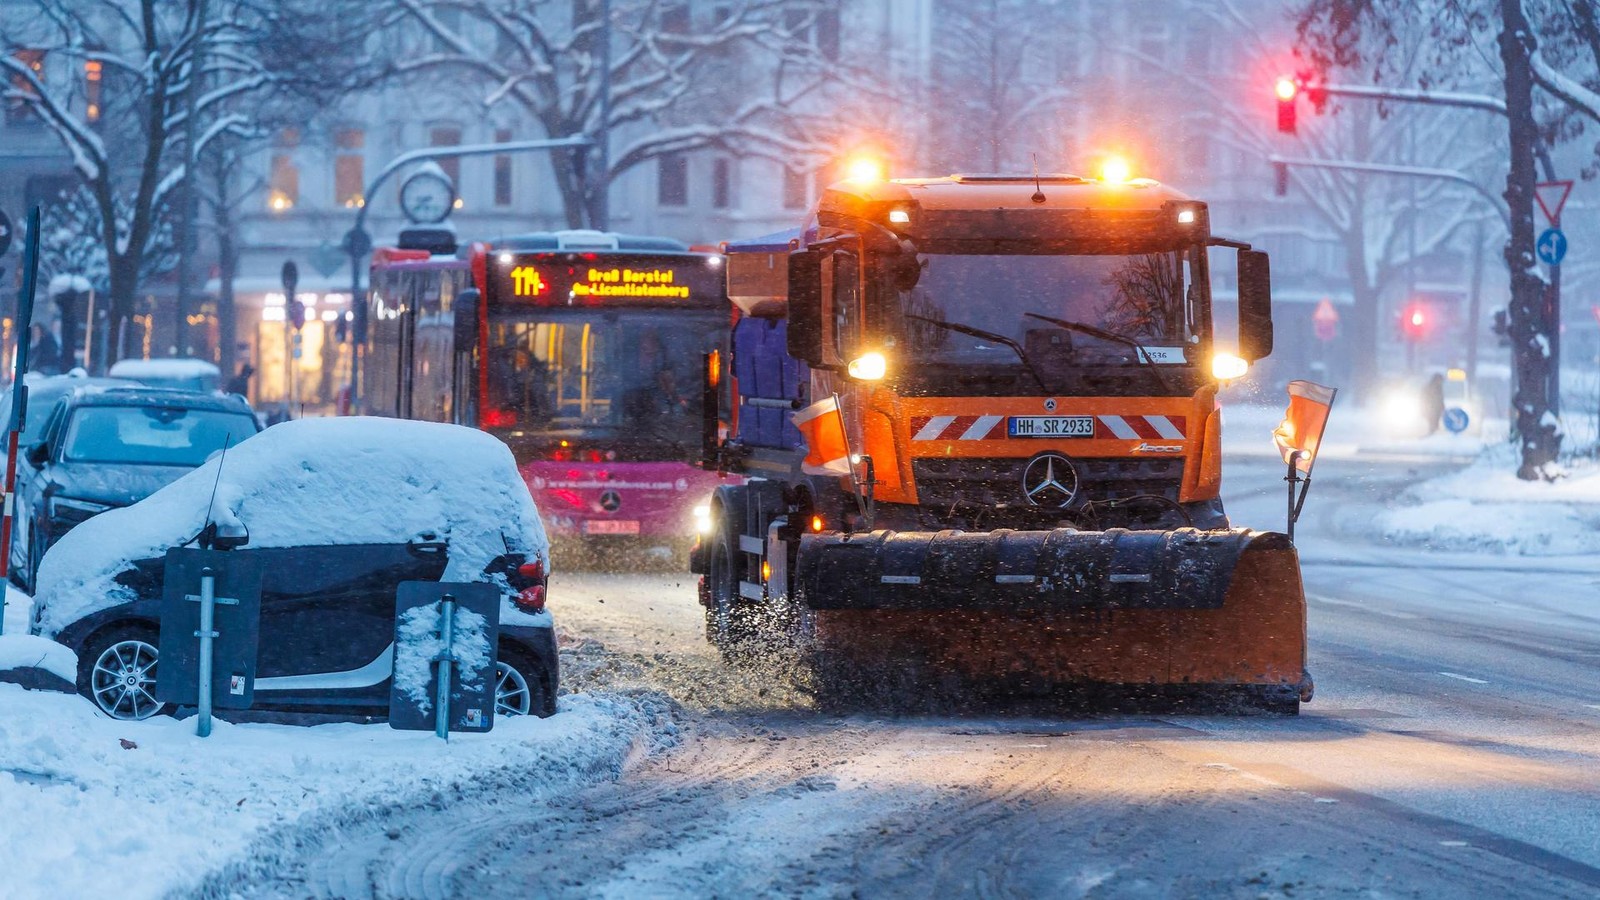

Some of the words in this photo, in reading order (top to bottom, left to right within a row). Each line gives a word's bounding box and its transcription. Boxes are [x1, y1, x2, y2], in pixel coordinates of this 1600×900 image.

[510, 266, 541, 296] 114
[623, 269, 673, 283] Borstel
[1018, 419, 1034, 433] HH
[1043, 419, 1059, 433] SR
[1062, 419, 1092, 433] 2933
